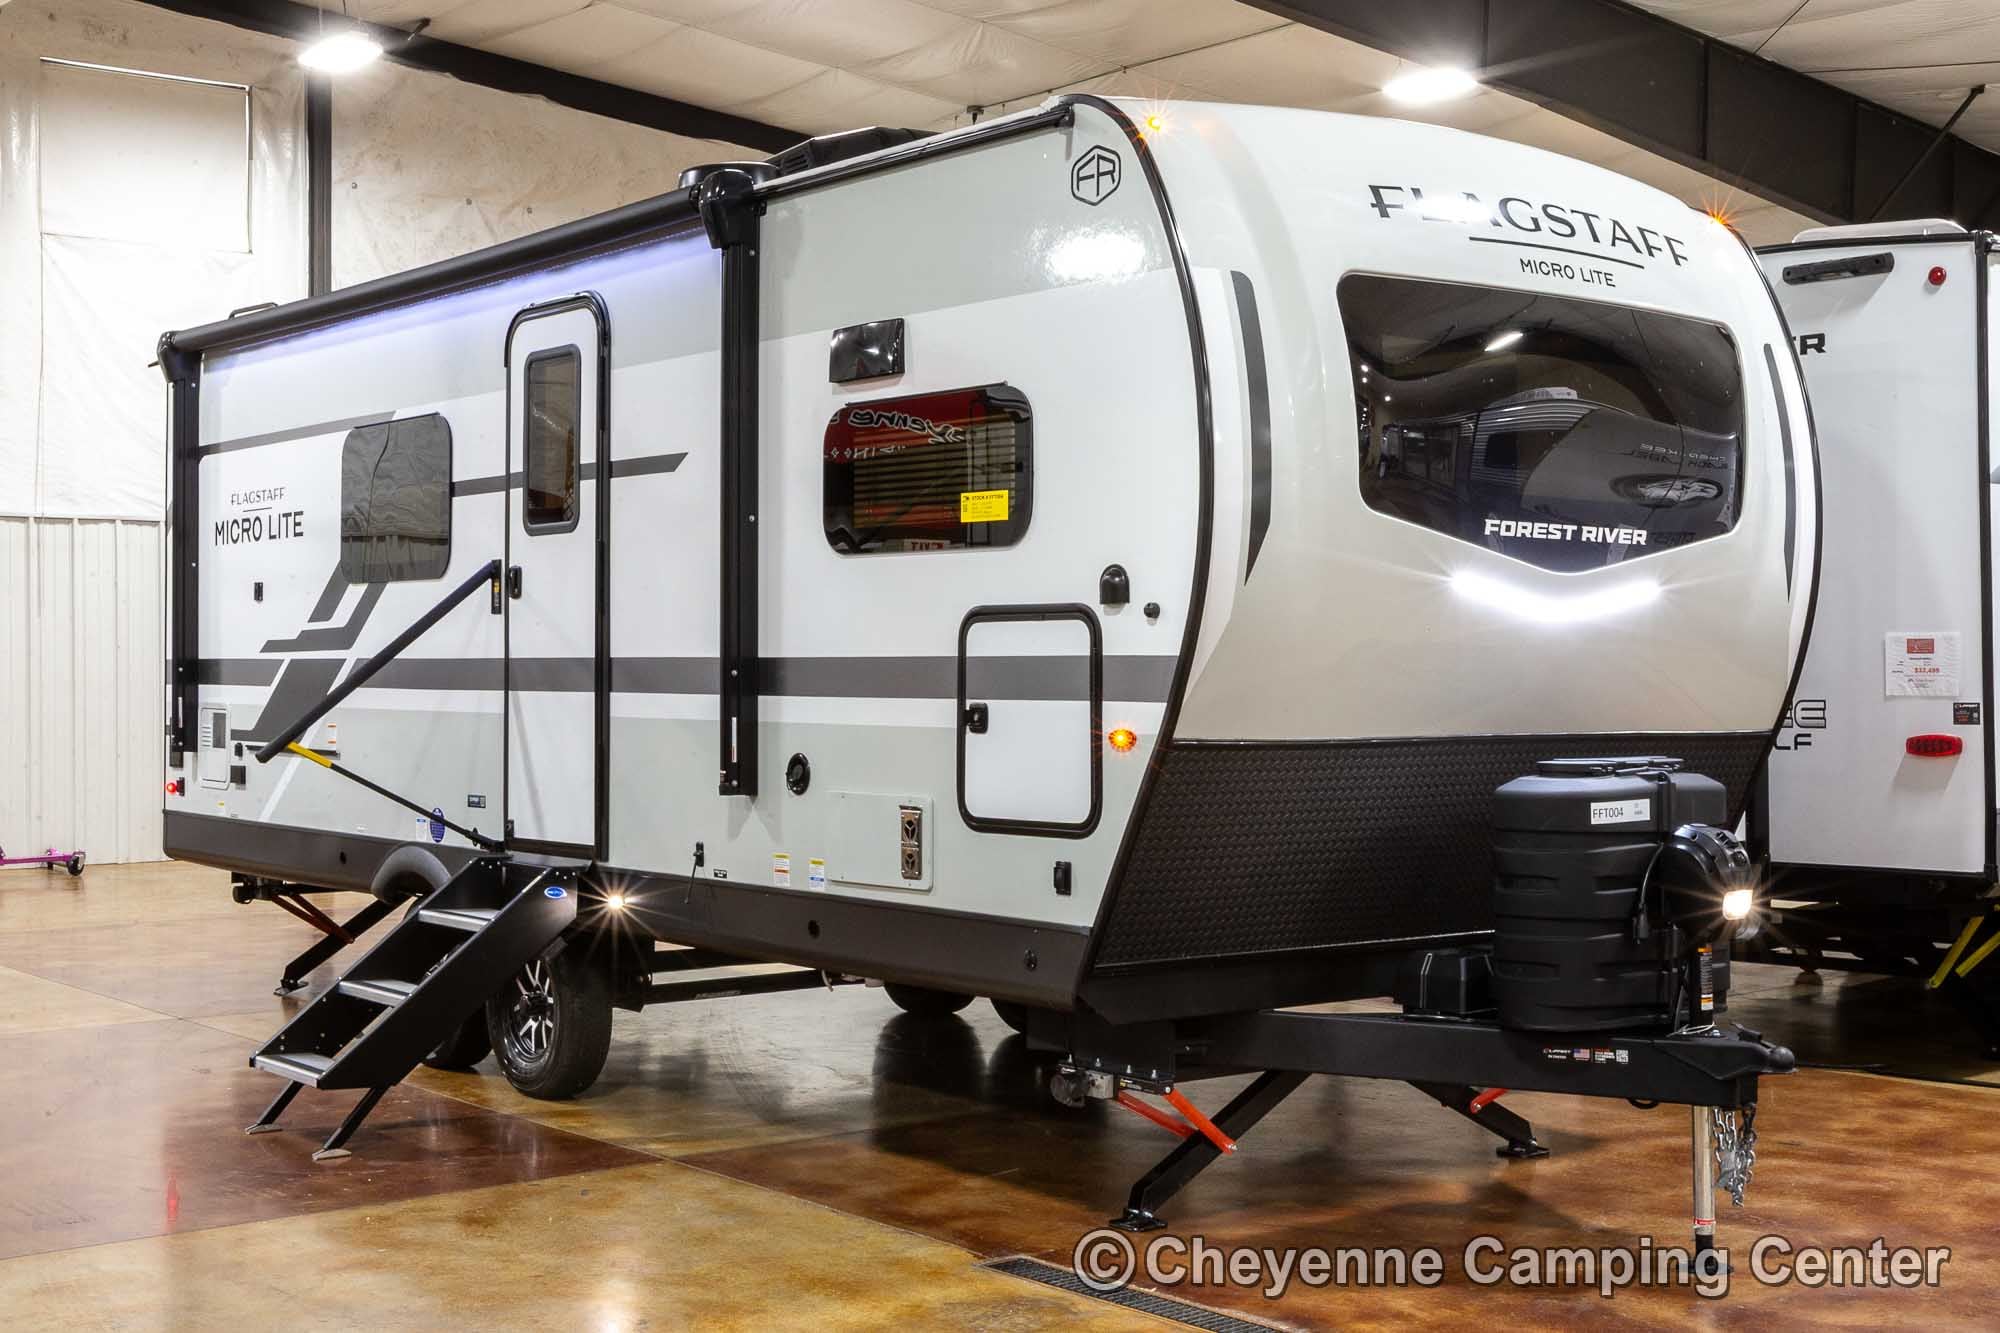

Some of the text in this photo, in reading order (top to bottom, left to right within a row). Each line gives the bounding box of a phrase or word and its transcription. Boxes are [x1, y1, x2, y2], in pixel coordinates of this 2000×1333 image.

[1519, 257, 1617, 288] MICRO LITE
[1792, 332, 1827, 356] R
[231, 487, 286, 505] FLAGSTAFF
[215, 510, 304, 546] MICRO LITE
[1484, 518, 1578, 541] FOREST
[1581, 525, 1648, 546] RIVER
[1592, 807, 1624, 819] FFT004
